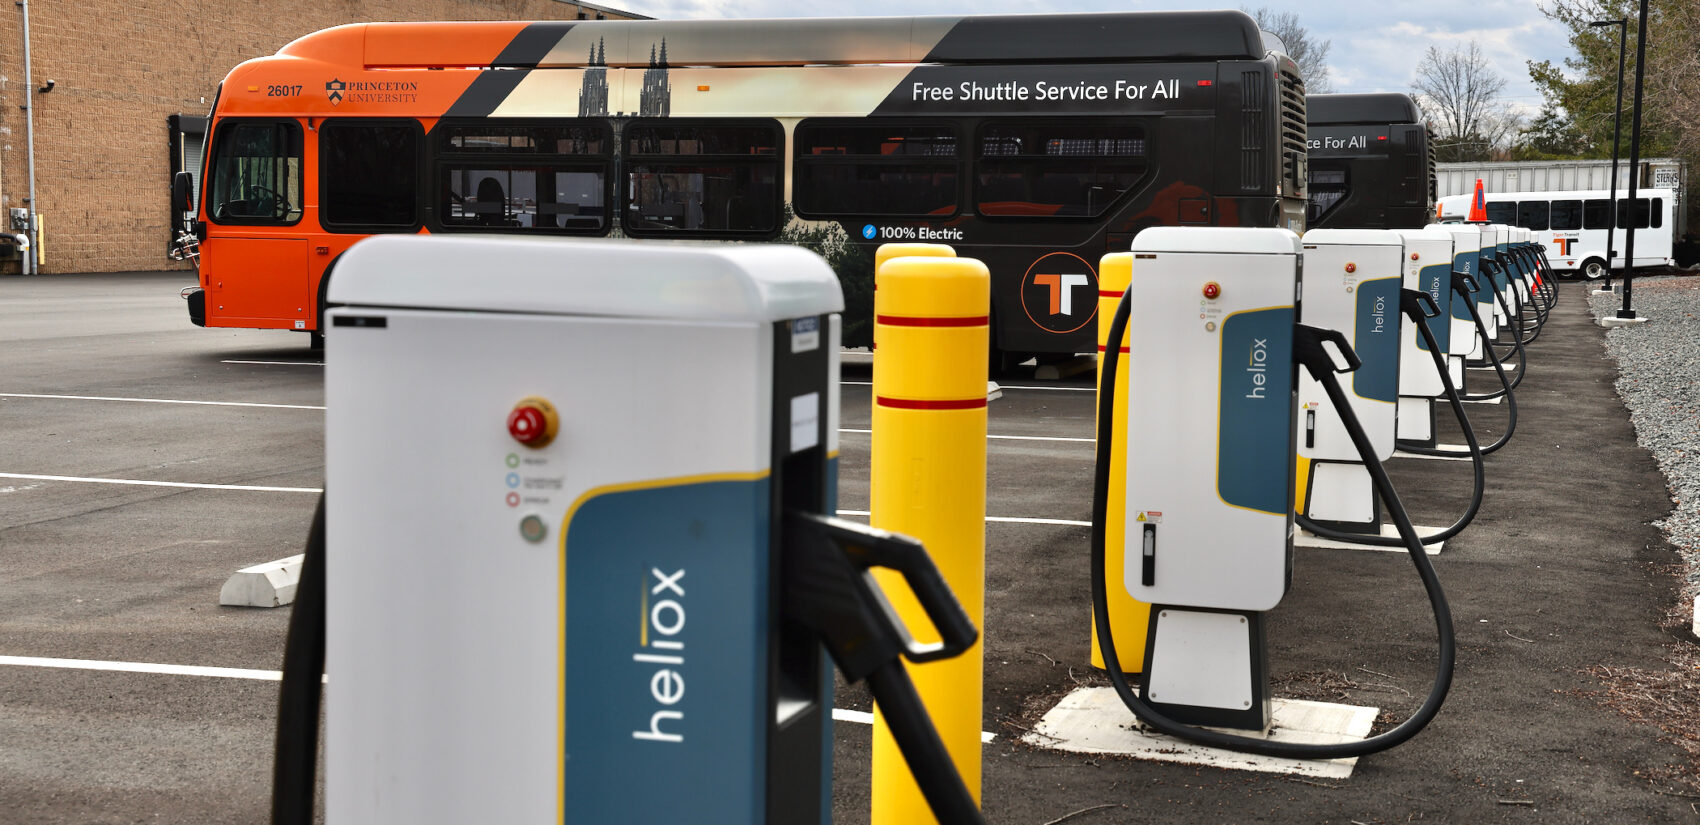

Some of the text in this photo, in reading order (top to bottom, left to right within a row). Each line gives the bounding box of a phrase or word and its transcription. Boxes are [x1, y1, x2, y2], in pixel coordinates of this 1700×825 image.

[267, 85, 303, 97] 26017
[349, 82, 418, 91] PRINCETON
[912, 79, 1180, 101] Free Shuttle Service For All
[348, 93, 418, 103] UNIVERSITY
[1324, 136, 1346, 149] For
[1347, 135, 1367, 149] All
[879, 226, 964, 240] 100% Electric
[1371, 295, 1385, 333] heliox
[1246, 338, 1267, 399] heliox
[632, 567, 686, 742] heliox
